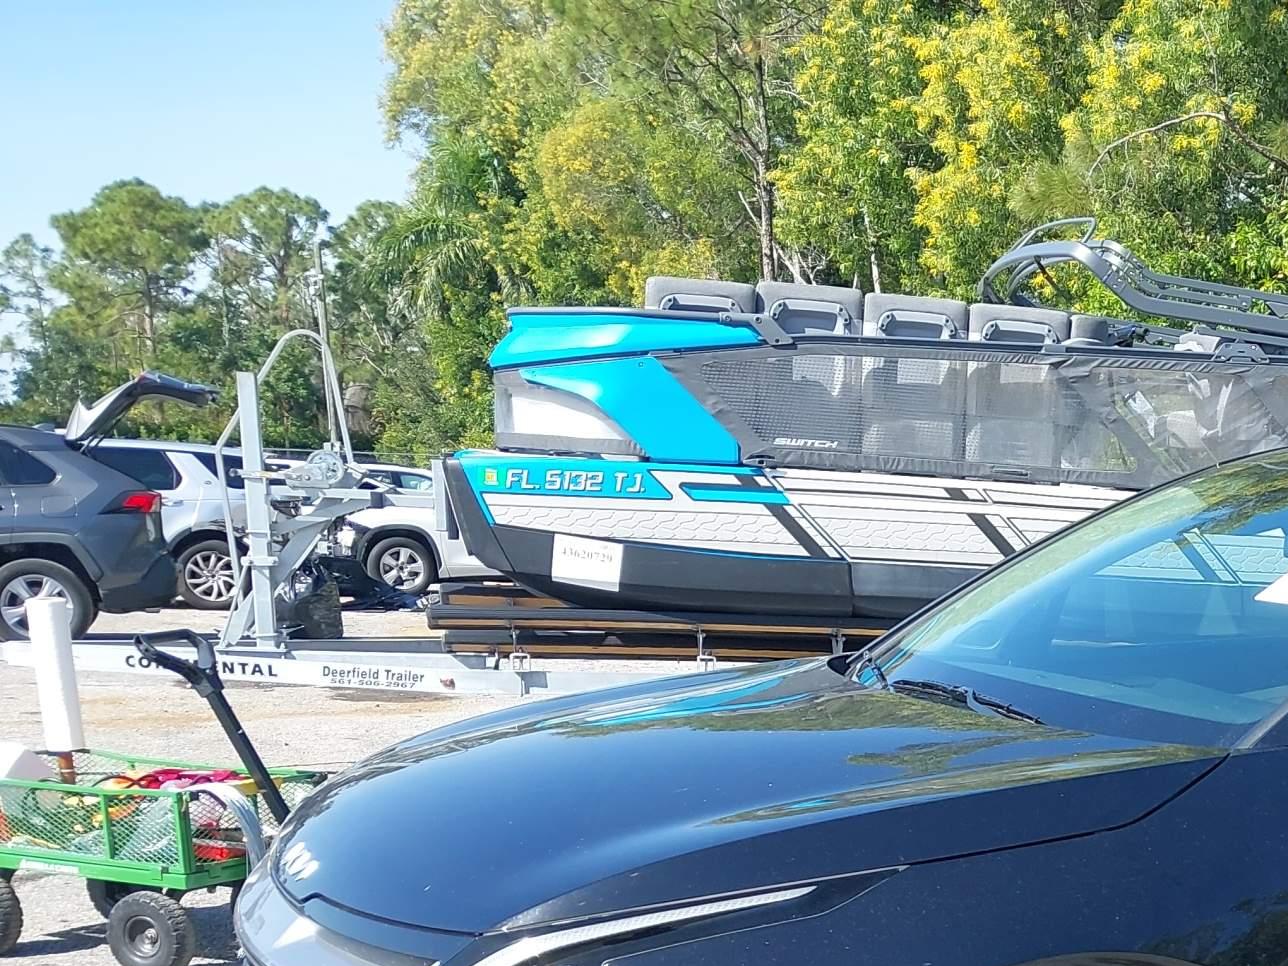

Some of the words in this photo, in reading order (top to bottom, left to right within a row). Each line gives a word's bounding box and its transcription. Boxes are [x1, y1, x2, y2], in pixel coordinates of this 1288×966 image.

[773, 437, 839, 449] SWITCH
[544, 469, 605, 492] 5132
[322, 665, 380, 680] Deerfield
[384, 669, 425, 683] Trailer
[330, 678, 416, 689] 561-506-2967
